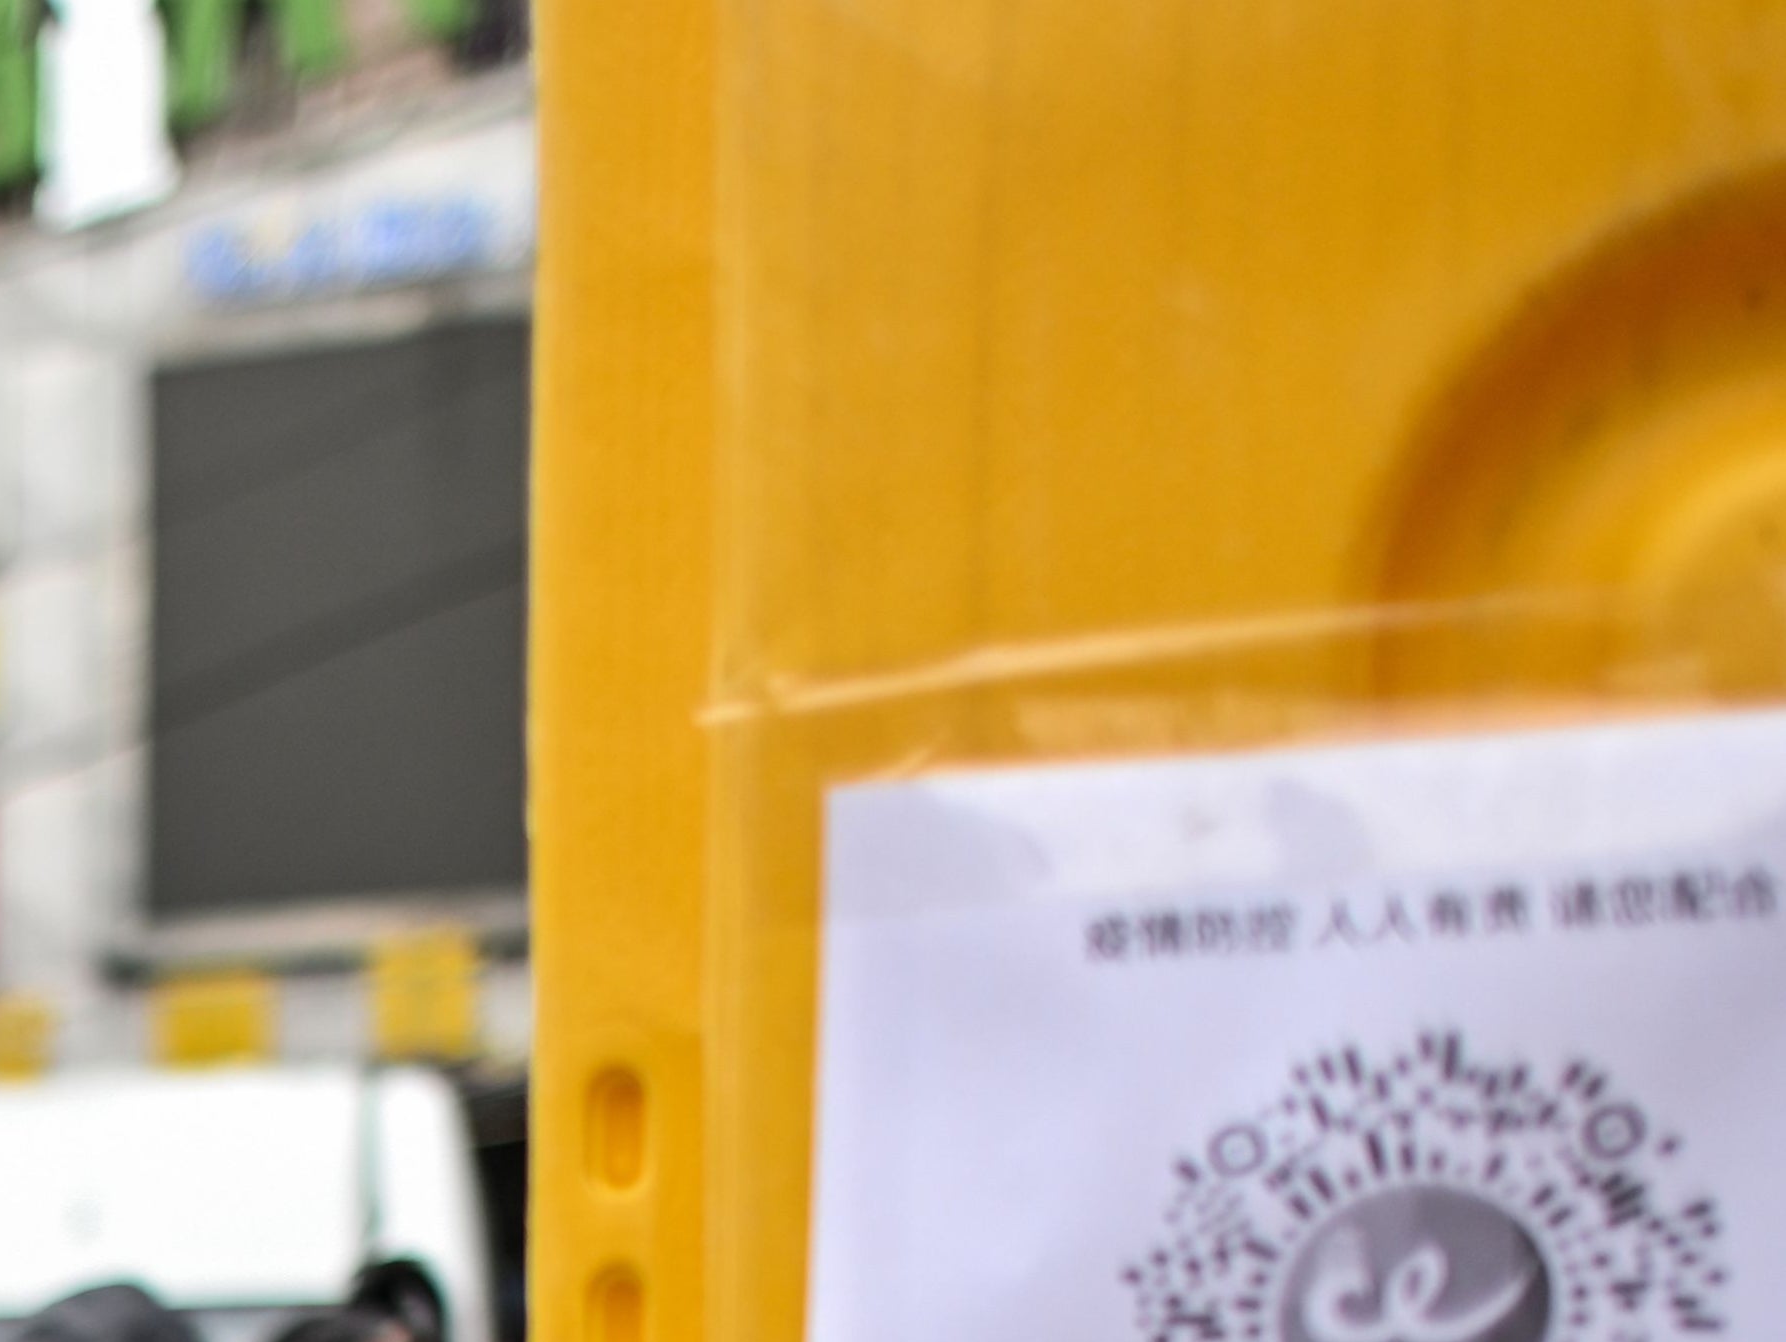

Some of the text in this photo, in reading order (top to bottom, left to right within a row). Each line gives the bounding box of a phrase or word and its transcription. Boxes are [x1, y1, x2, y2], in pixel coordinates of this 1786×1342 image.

[1084, 900, 1296, 962] 疫情防控
[1312, 884, 1528, 946] 人人有责
